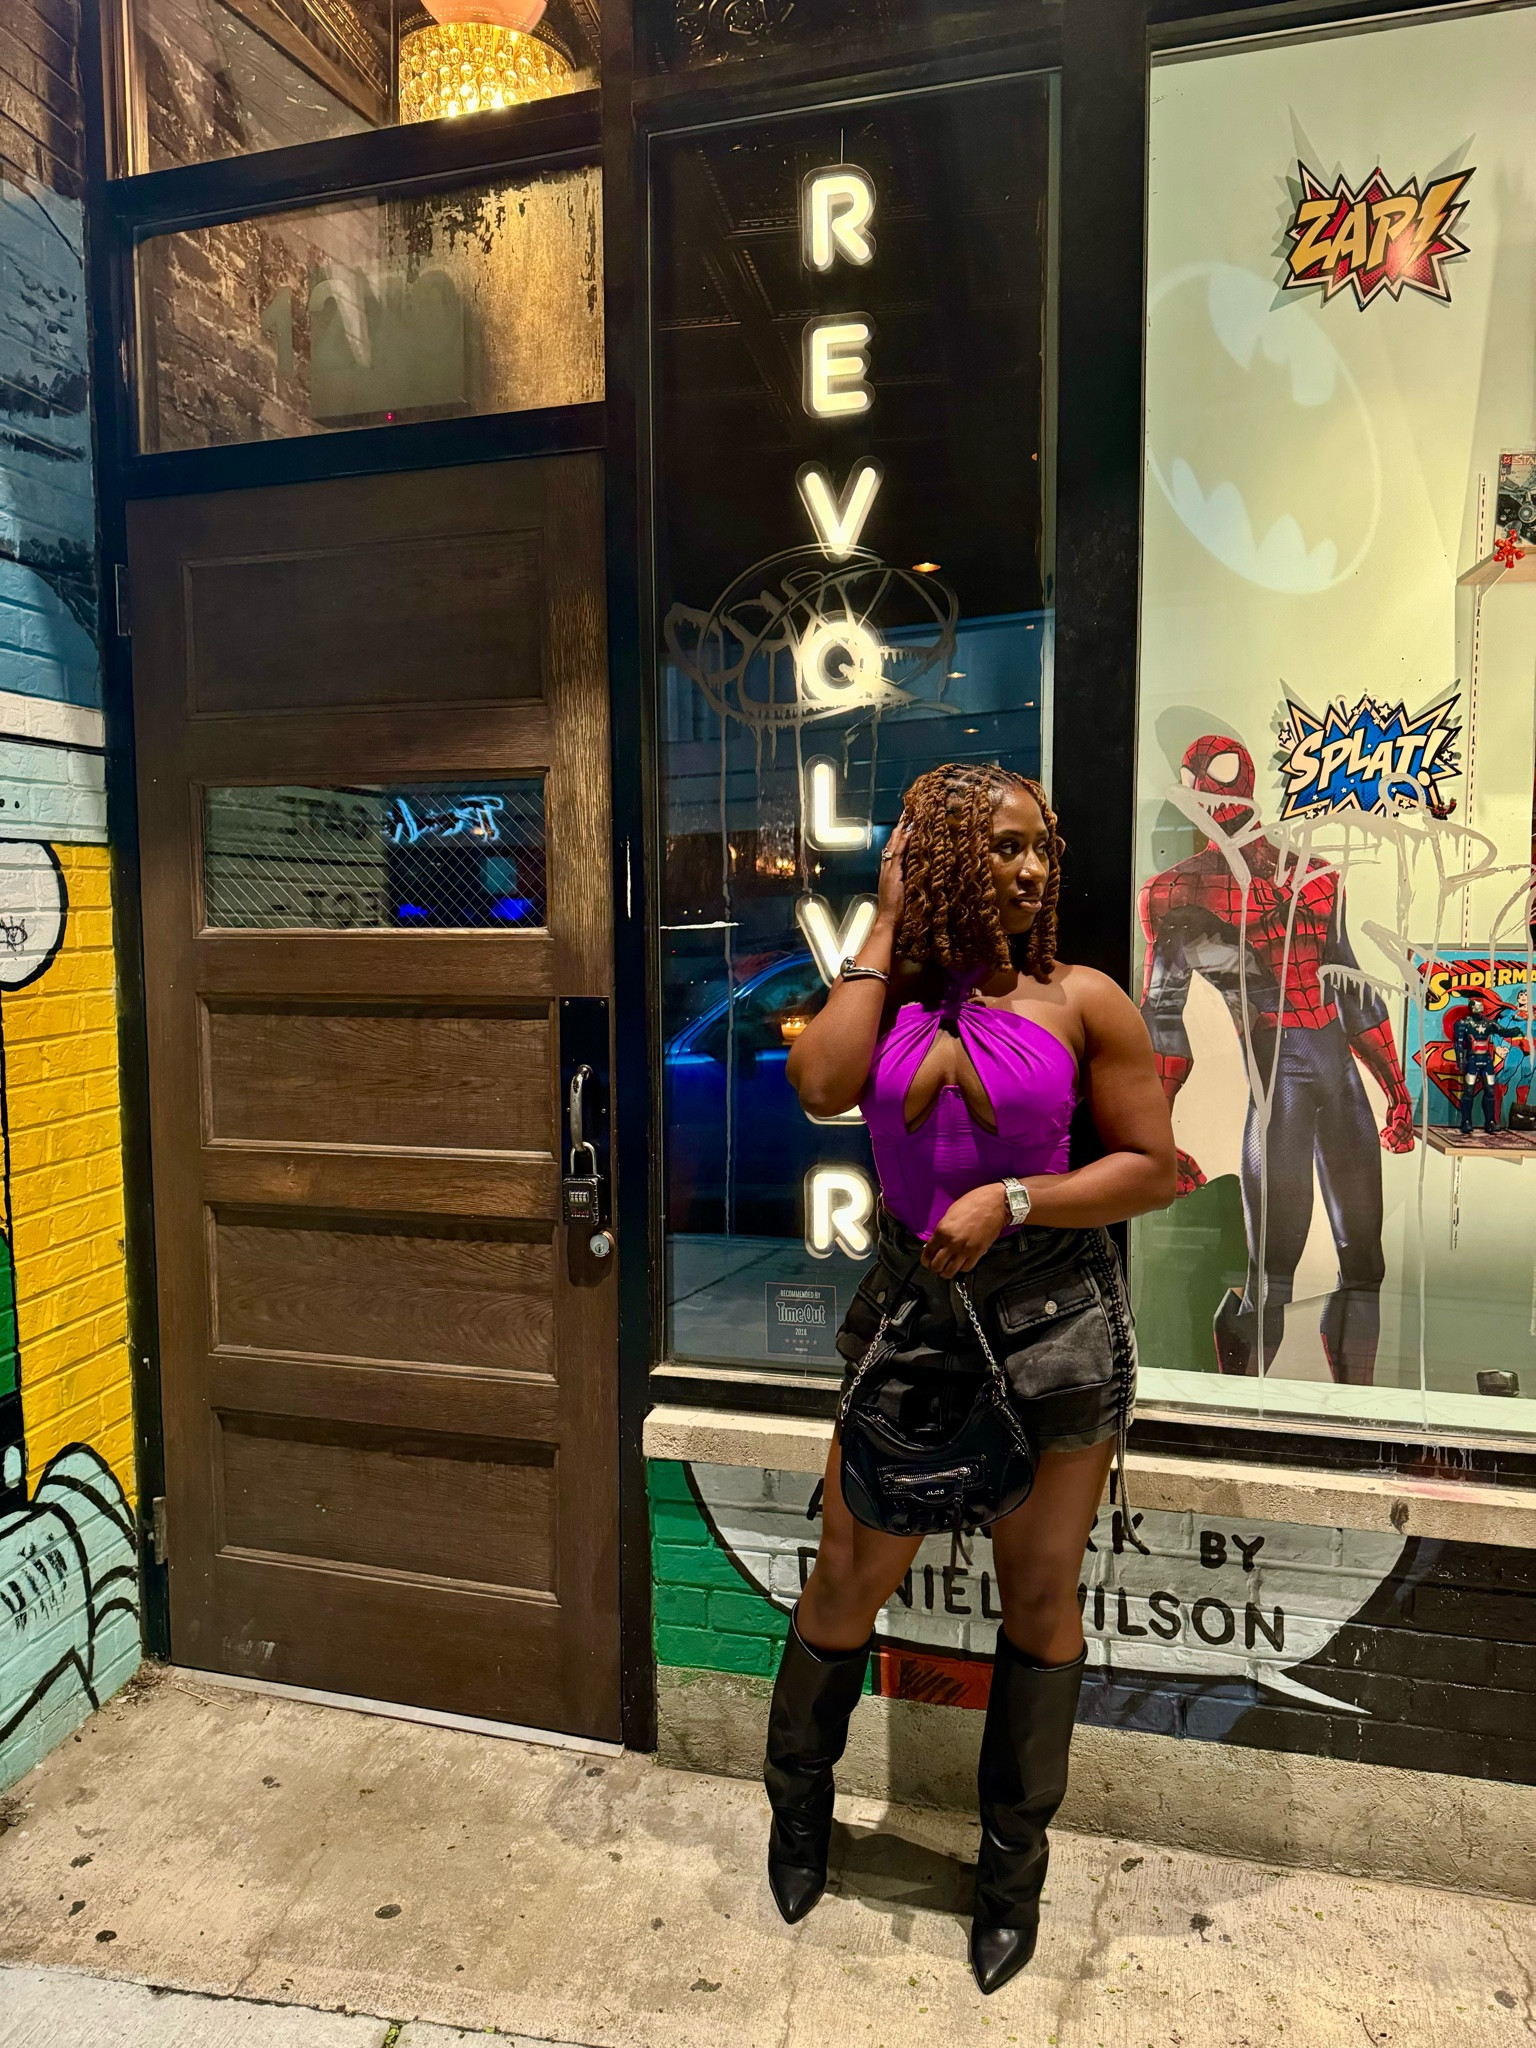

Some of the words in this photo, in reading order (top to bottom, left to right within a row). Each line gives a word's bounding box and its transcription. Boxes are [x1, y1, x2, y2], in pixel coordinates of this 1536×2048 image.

[1290, 175, 1466, 276] ZAP!
[1287, 729, 1448, 795] SPLAT!
[780, 1289, 814, 1299] RECOMMENDED
[814, 1291, 821, 1299] BY
[1200, 1530, 1265, 1572] BY
[1077, 1582, 1285, 1652] ILSON
